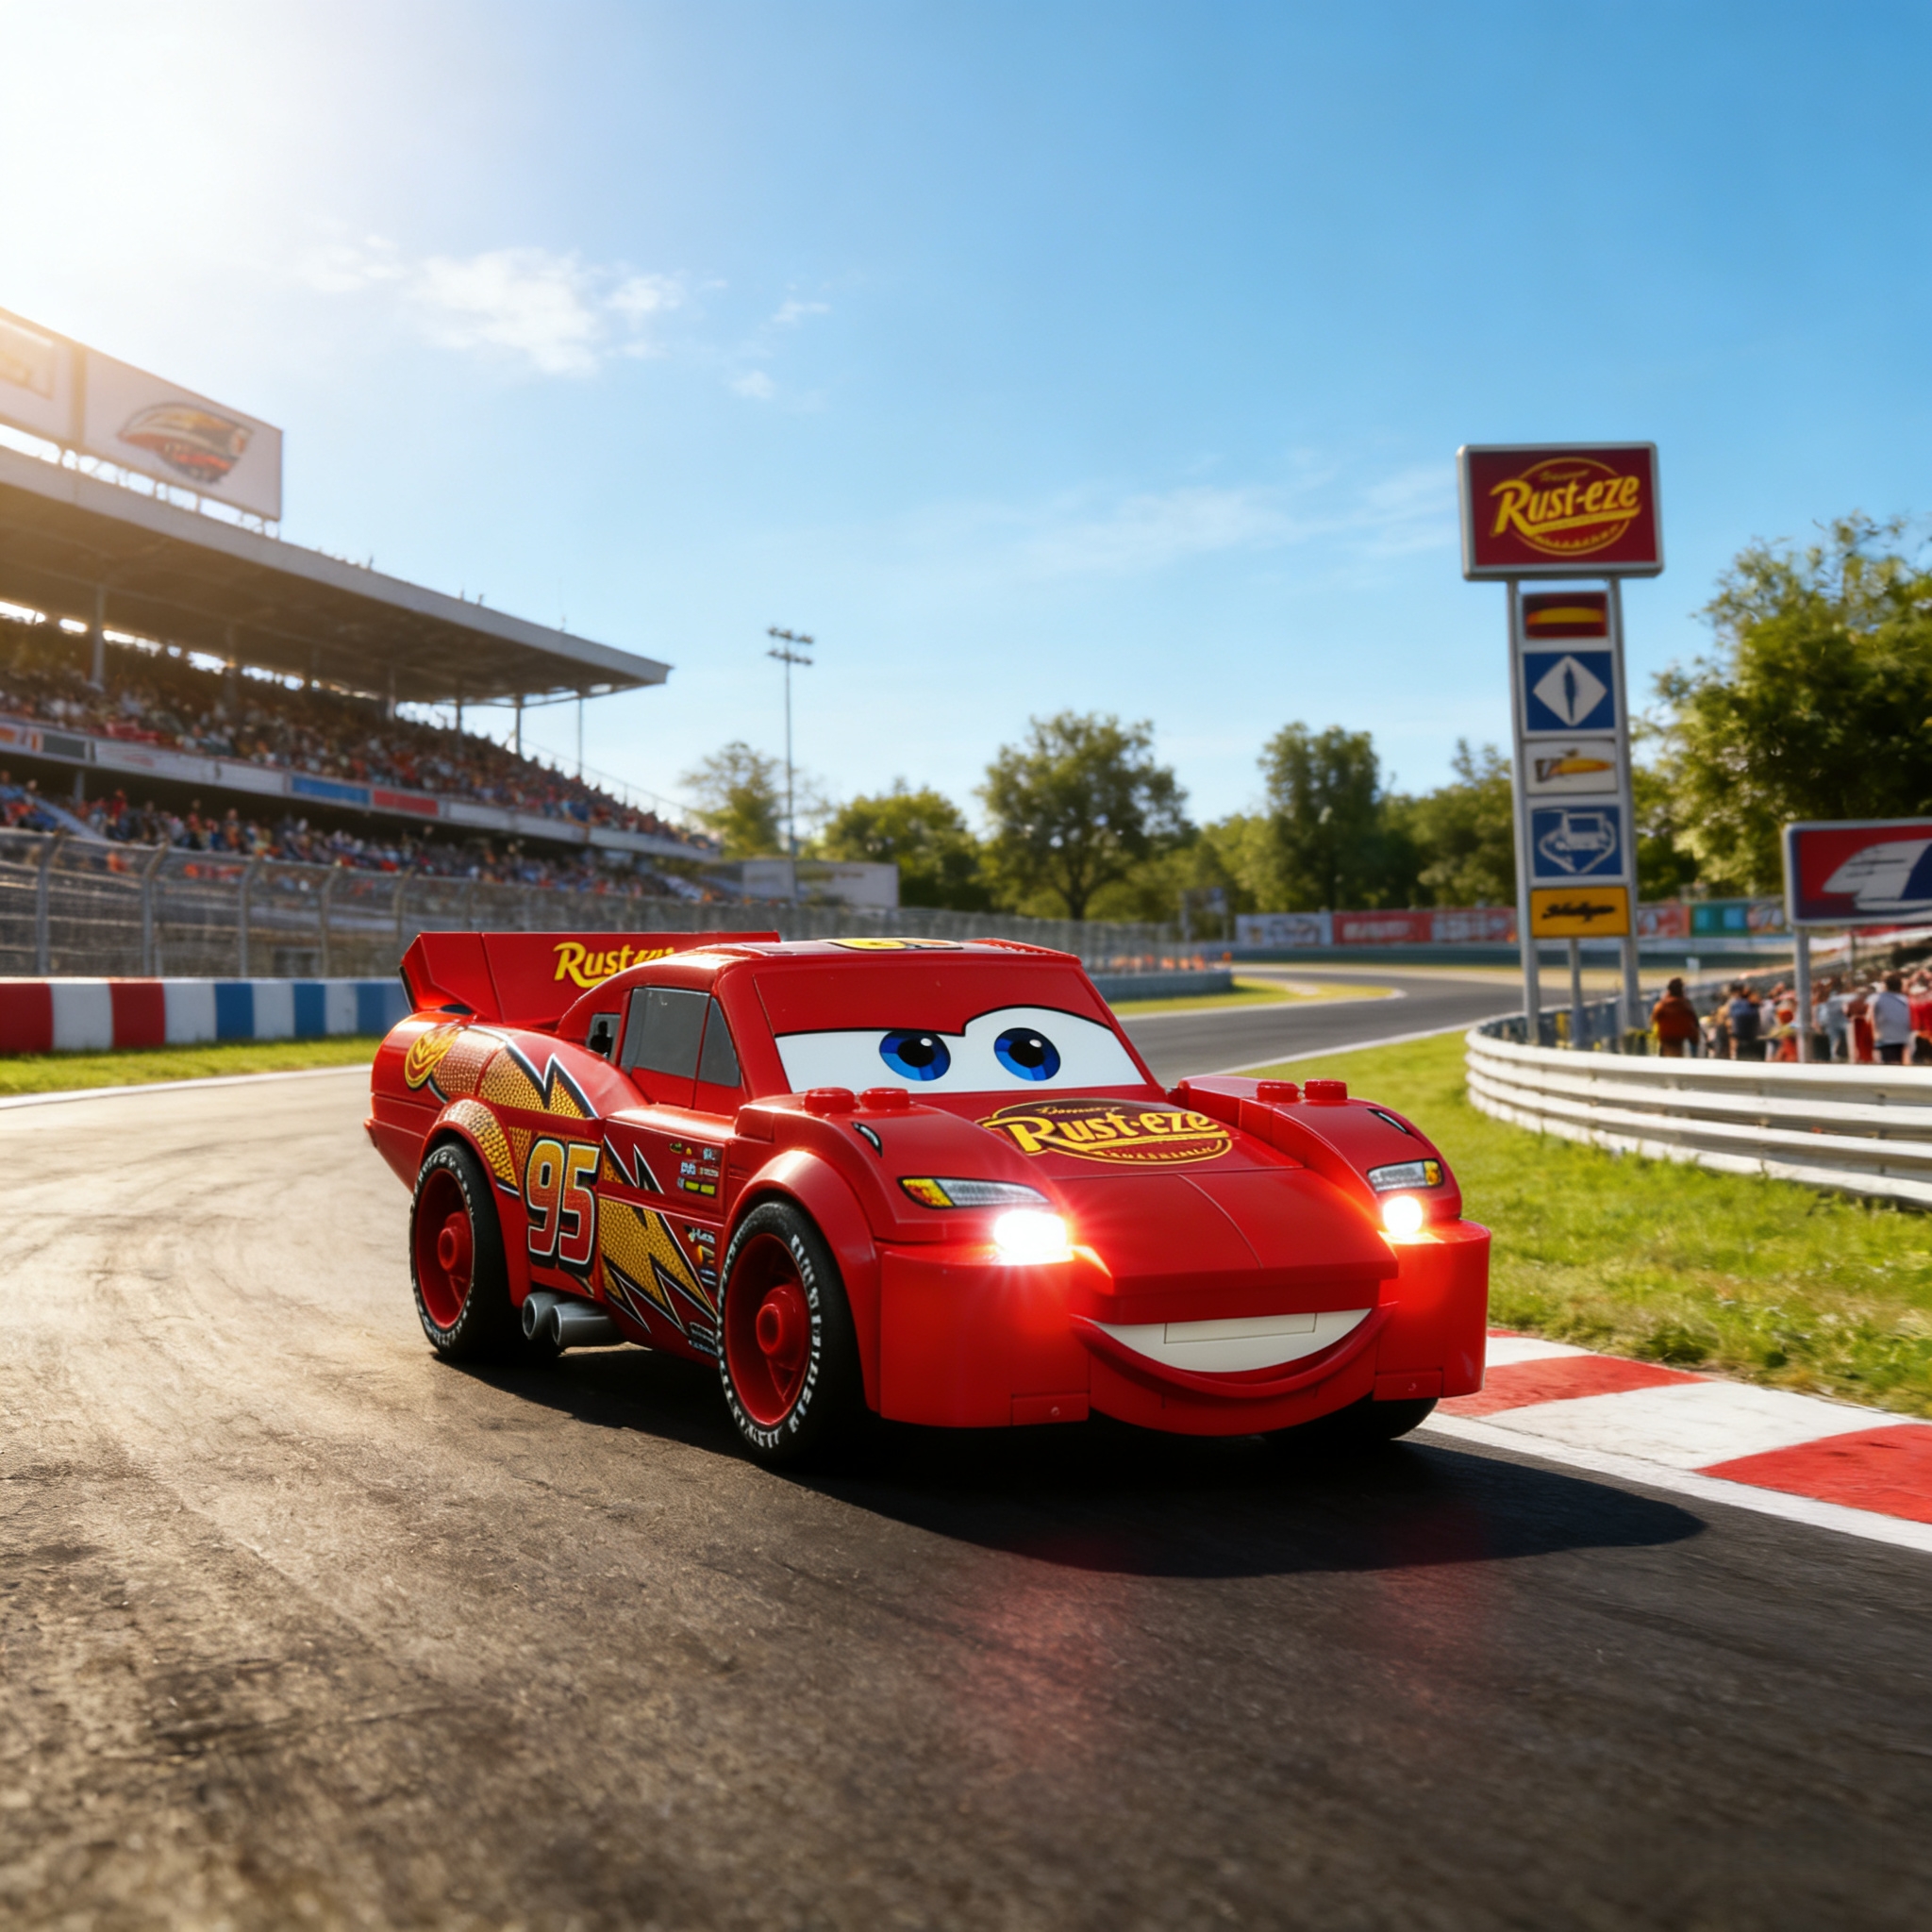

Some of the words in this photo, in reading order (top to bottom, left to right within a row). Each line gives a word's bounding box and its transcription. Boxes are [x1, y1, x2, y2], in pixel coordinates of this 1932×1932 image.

[1490, 475, 1641, 538] Rust-eze
[982, 1110, 1229, 1153] Rust-eze
[525, 1139, 601, 1266] 95
